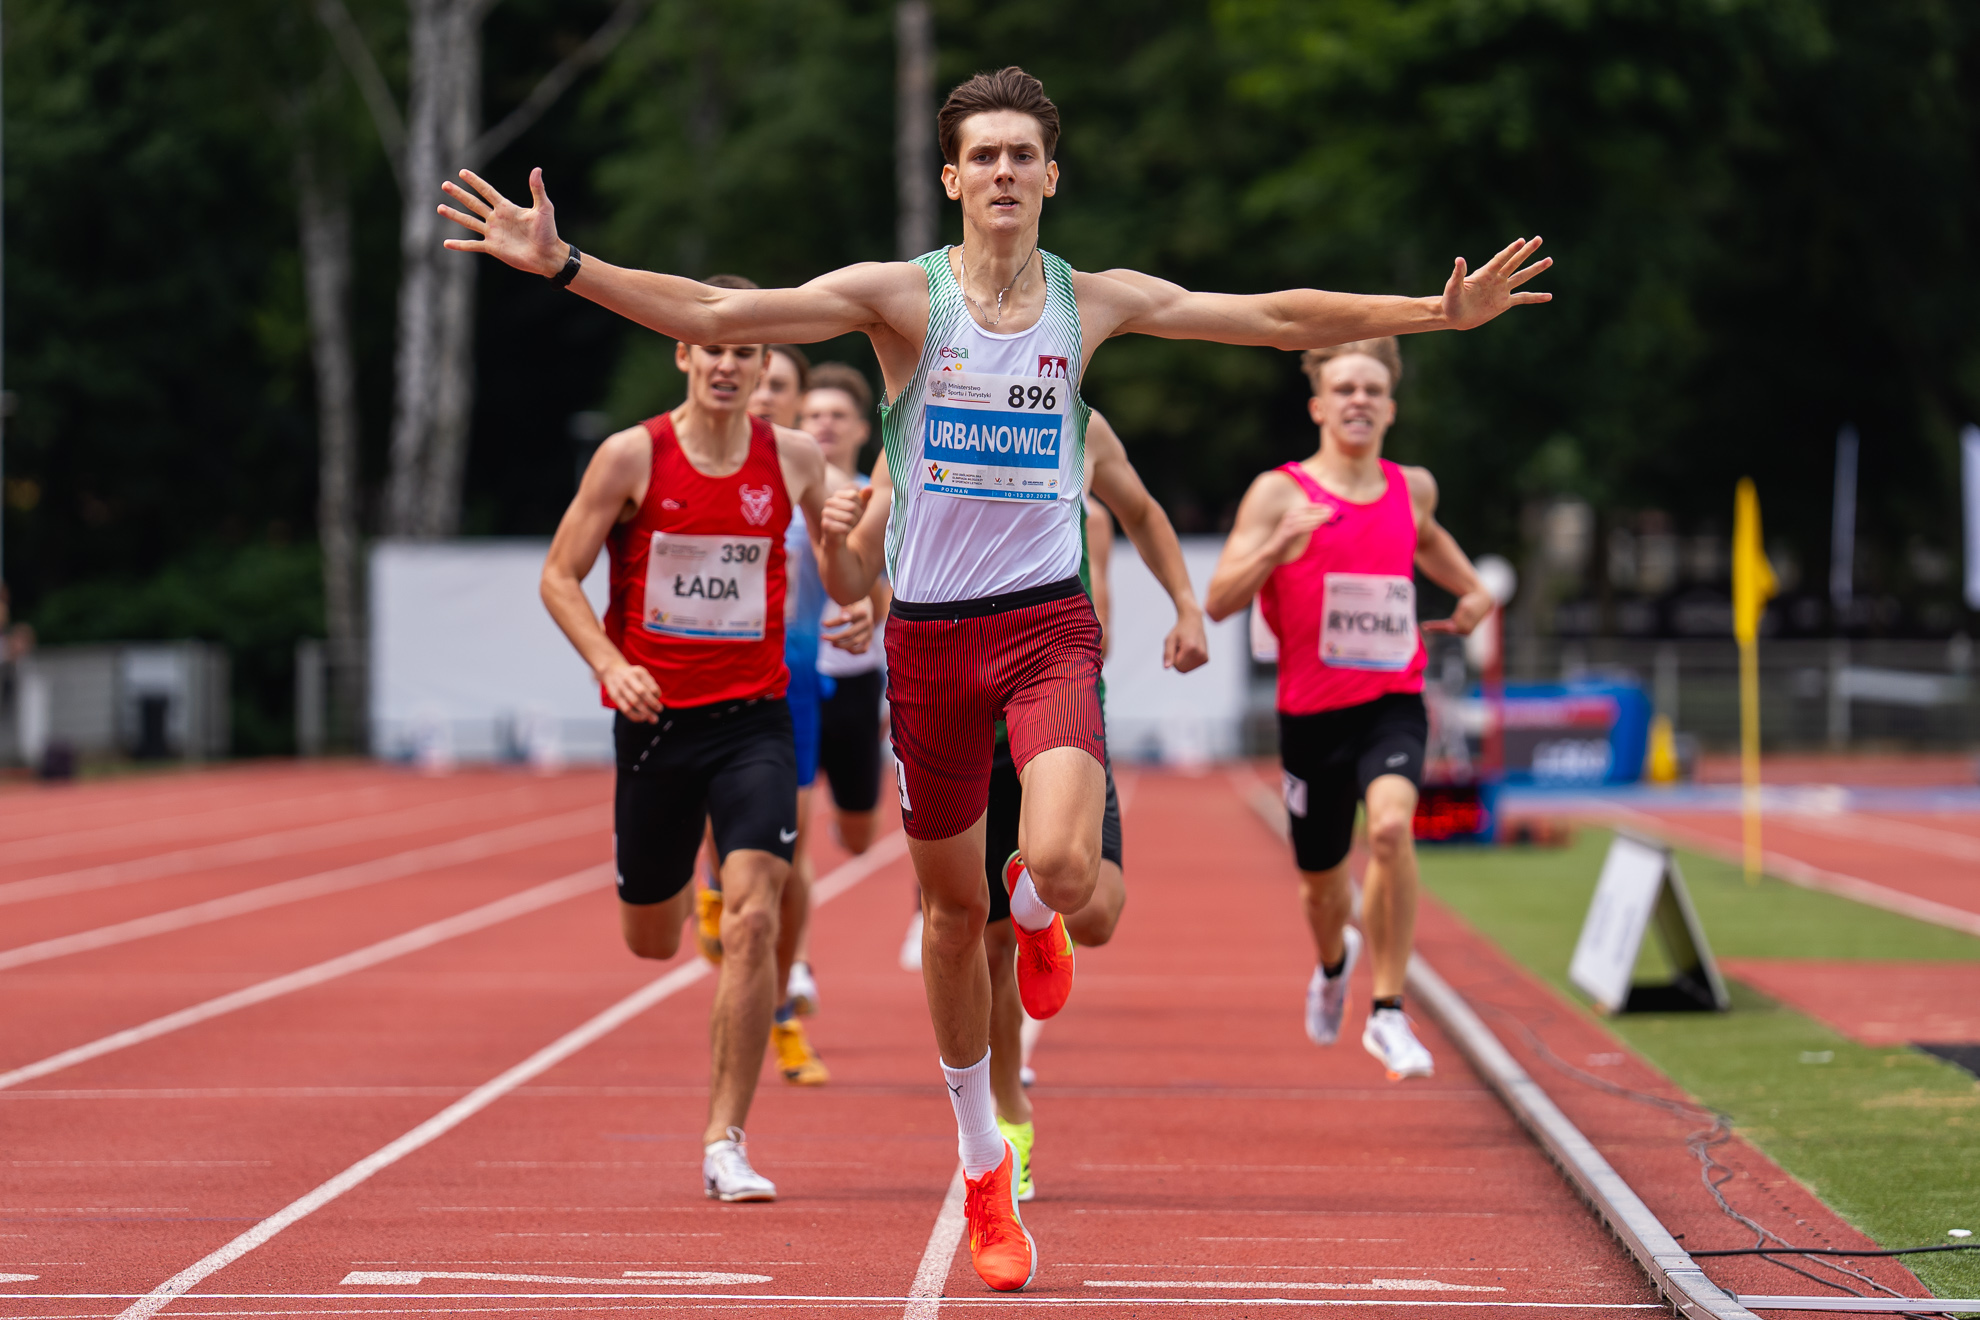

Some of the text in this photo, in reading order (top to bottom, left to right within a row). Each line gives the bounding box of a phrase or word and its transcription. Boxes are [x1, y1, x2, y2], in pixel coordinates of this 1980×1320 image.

[948, 383, 981, 391] Ministerstwo
[1008, 384, 1057, 410] 896
[929, 419, 1058, 456] URBANOWICZ
[940, 487, 969, 495] POZNAŃ
[721, 543, 760, 563] 330
[673, 574, 739, 600] ŁADA
